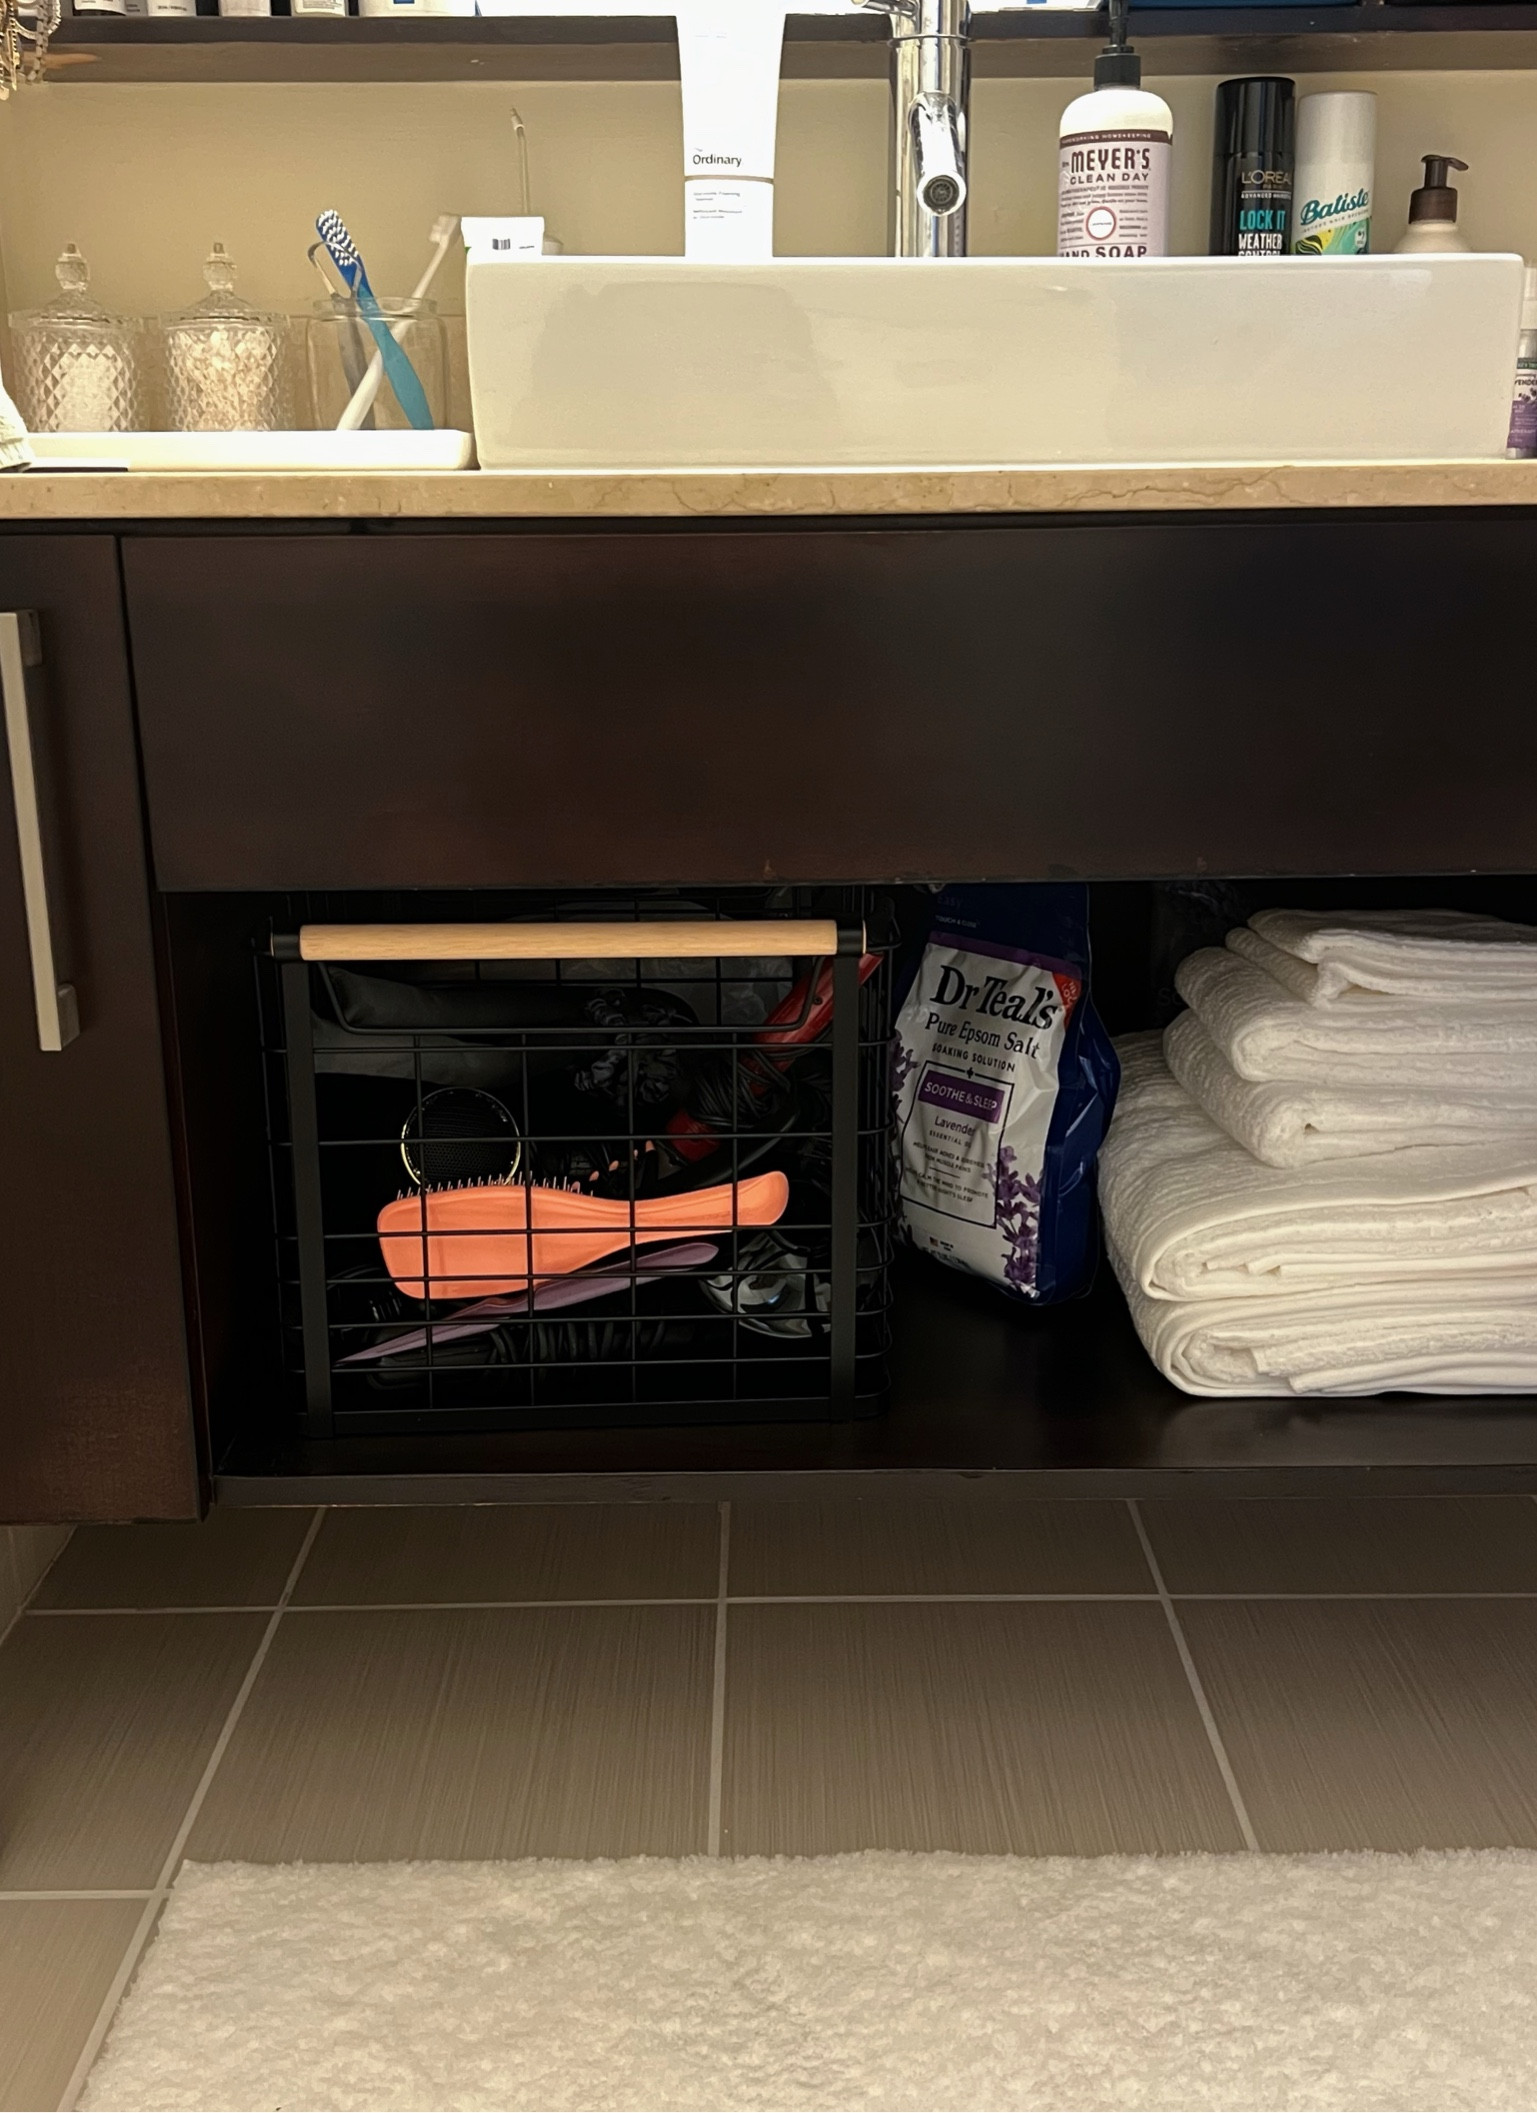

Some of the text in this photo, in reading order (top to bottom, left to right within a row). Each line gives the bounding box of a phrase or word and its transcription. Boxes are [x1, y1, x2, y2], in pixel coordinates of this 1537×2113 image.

[692, 153, 742, 168] Ordinary
[1071, 148, 1151, 173] MEYER'S
[1070, 173, 1149, 185] CLEAN DAY
[1300, 187, 1369, 226] Batiste
[1240, 210, 1286, 230] LOCK IT
[1096, 246, 1148, 257] SOAP
[1238, 233, 1283, 250] WEATHER
[930, 965, 1058, 1030] Dr Teal's
[925, 1012, 1041, 1060] Pure Epsom Salt
[932, 1042, 1015, 1073] SOAKING SOLUTION
[924, 1081, 966, 1103] SOOTHE
[934, 1115, 977, 1137] Lavender
[929, 1130, 962, 1145] ESSENTIAL
